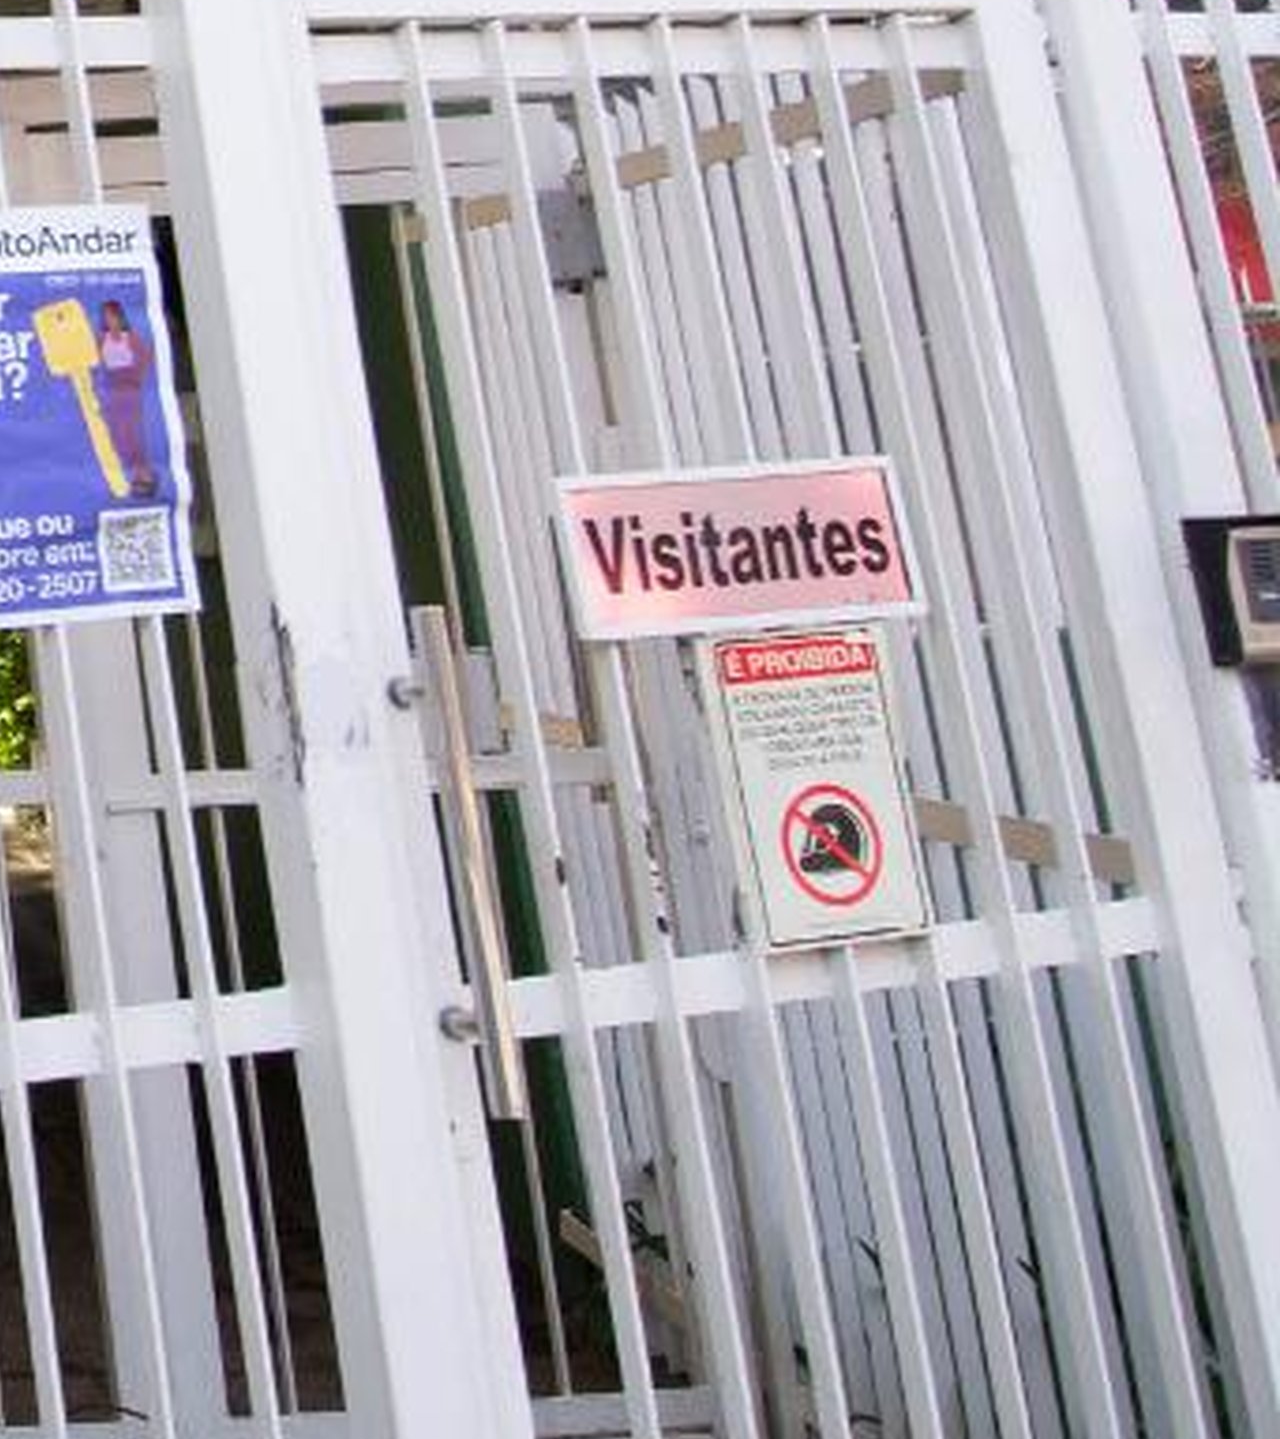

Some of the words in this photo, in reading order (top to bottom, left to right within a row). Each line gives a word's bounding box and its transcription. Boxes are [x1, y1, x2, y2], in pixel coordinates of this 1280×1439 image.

[37, 514, 75, 536] ou
[582, 506, 891, 595] Visitantes
[724, 648, 746, 679] É
[747, 642, 870, 677] PROIBIDA
